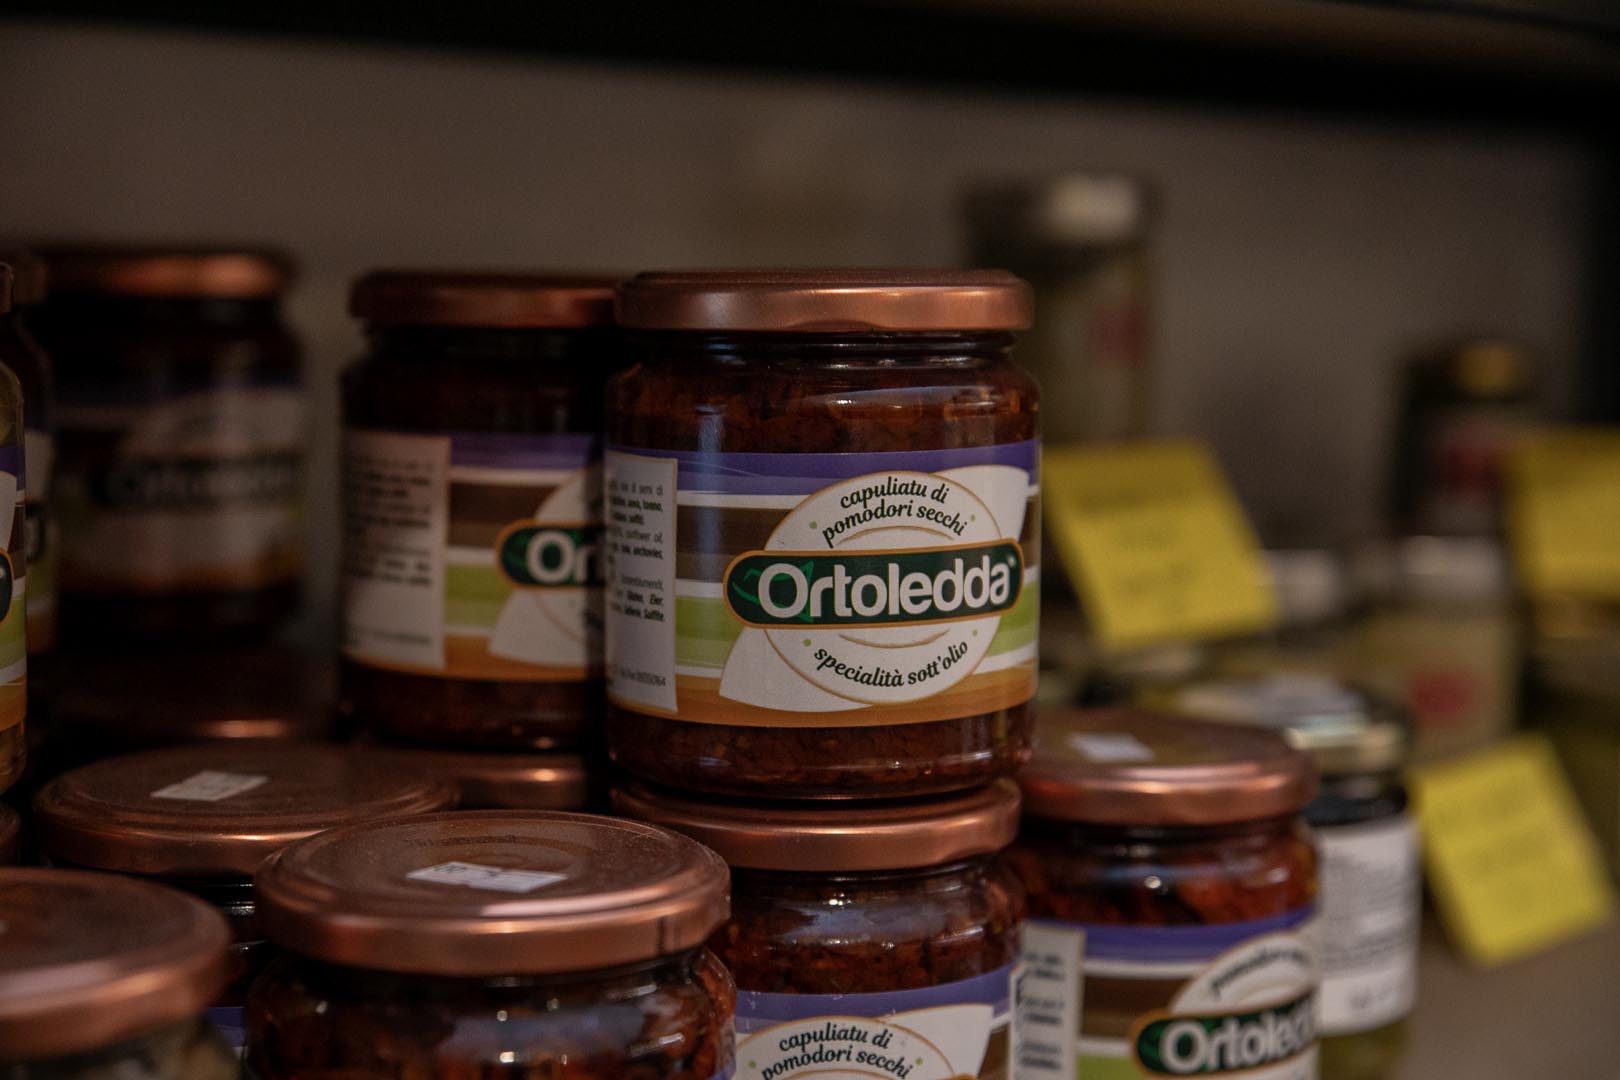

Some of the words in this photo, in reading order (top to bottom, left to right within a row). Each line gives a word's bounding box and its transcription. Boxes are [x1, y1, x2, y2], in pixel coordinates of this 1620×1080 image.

[840, 476, 927, 508] capuliatu
[931, 483, 949, 503] di
[822, 499, 913, 548] pomodori
[916, 503, 967, 536] secchi
[758, 556, 1010, 618] Ortoledda
[814, 648, 904, 687] specialità
[907, 641, 968, 685] sott'olio
[779, 1022, 868, 1052] capuliatu
[872, 1029, 893, 1049] di
[762, 1044, 852, 1080] pomodori
[856, 1050, 913, 1079] secchi
